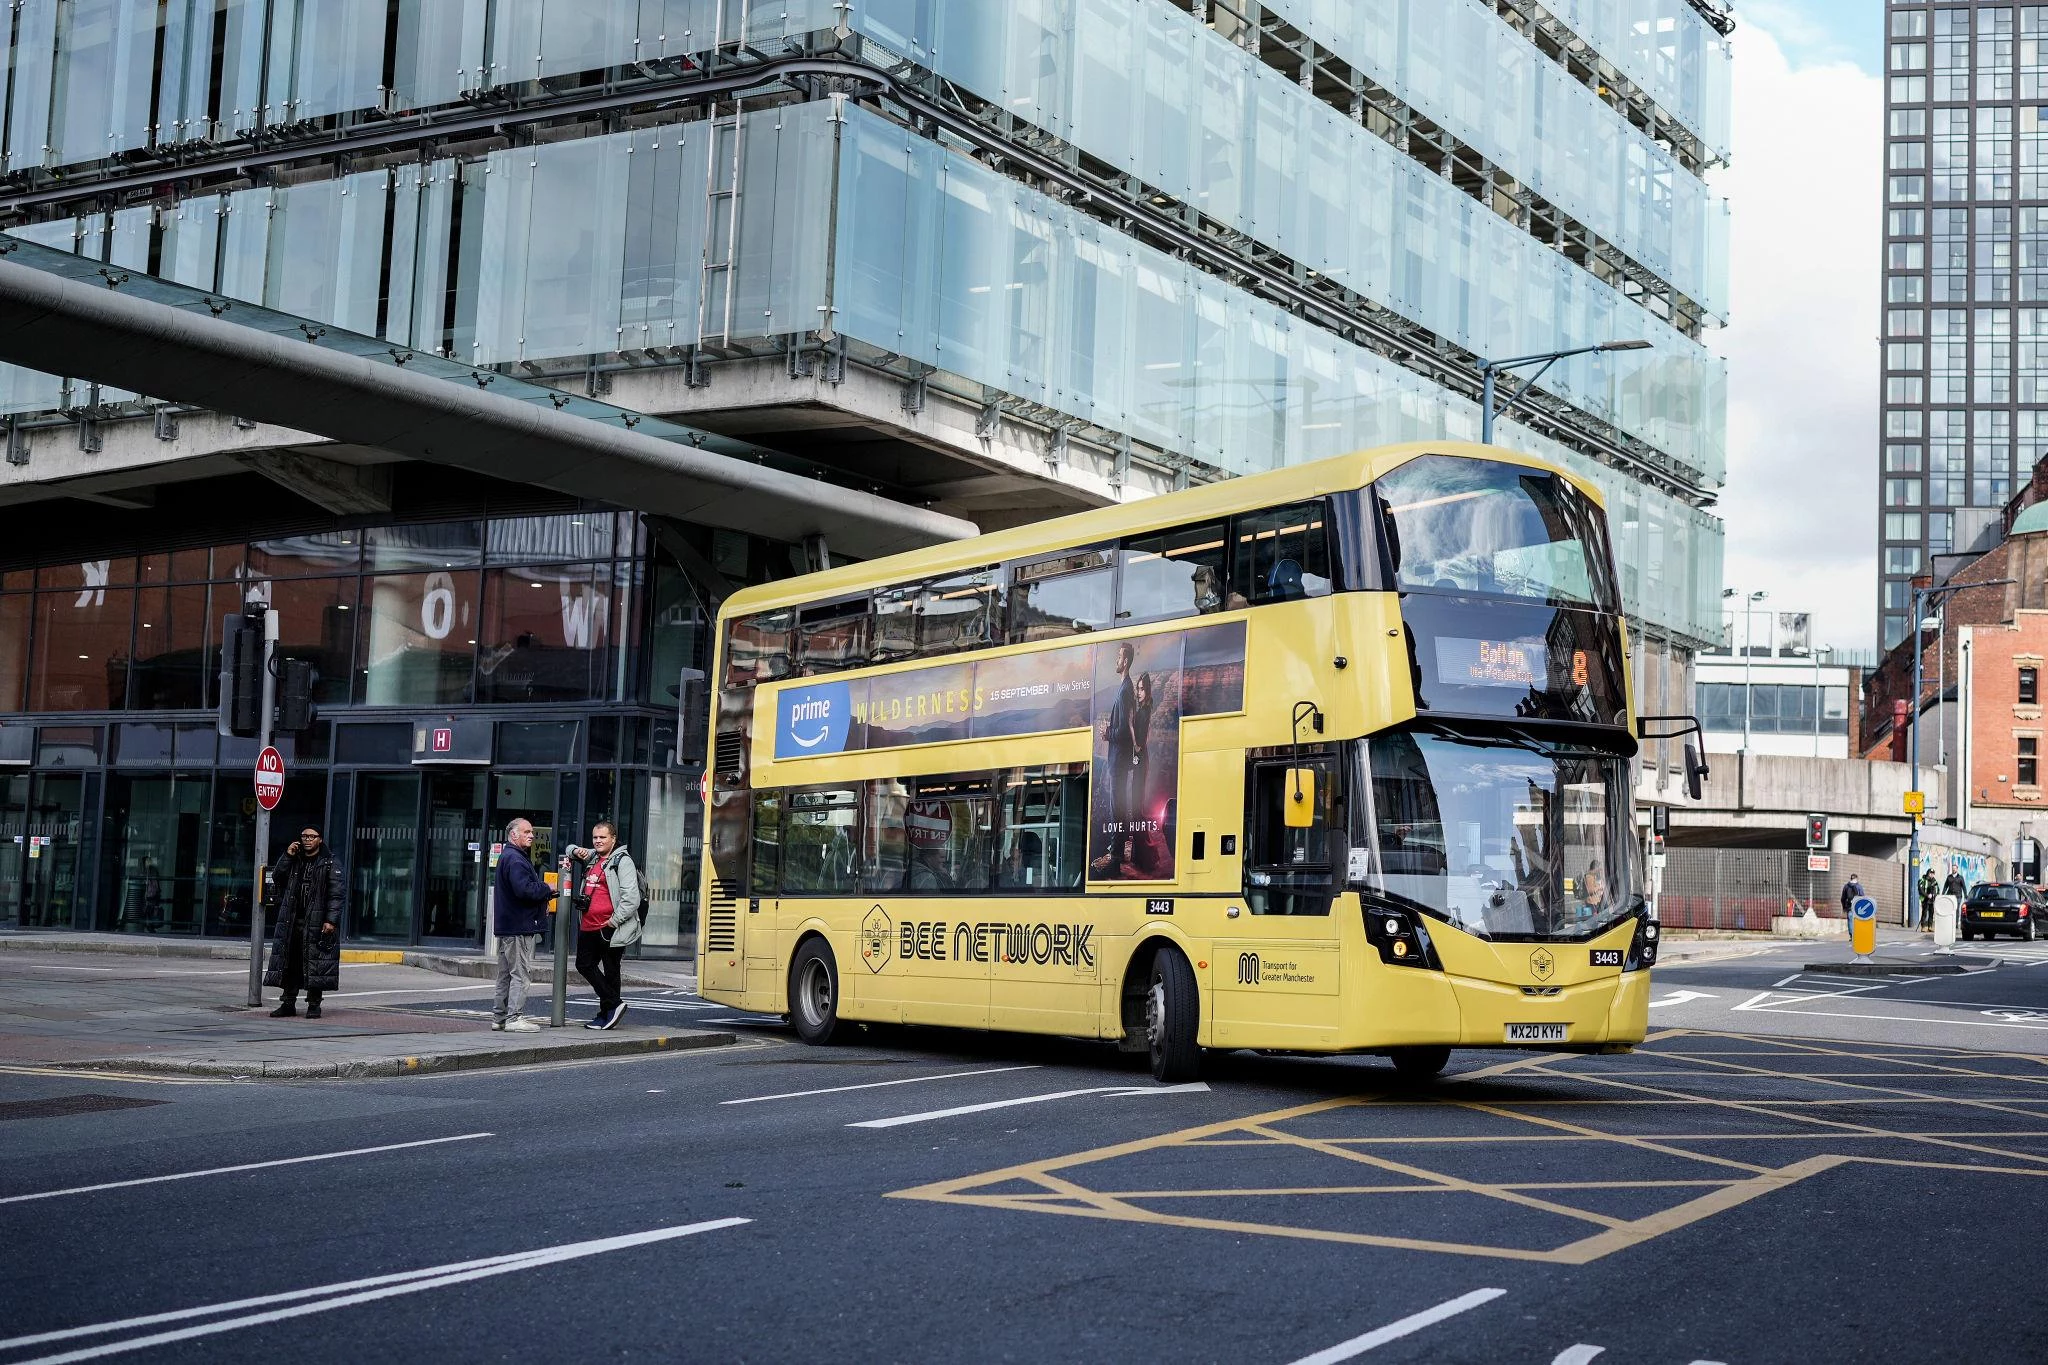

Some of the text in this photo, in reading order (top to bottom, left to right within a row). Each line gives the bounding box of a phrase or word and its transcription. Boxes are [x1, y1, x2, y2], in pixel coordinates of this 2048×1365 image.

[1480, 641, 1524, 666] Bolton
[1572, 651, 1587, 686] 8
[990, 679, 1090, 701] 15 SEPTEMBER New Series
[791, 696, 830, 728] prime
[856, 688, 985, 725] WILDERNESS
[437, 732, 446, 747] H
[263, 755, 277, 770] NO
[258, 786, 279, 797] ENTRY
[1102, 820, 1160, 833] LOVE. HURTS.
[1150, 901, 1170, 913] 3443
[899, 921, 1094, 966] BEE NETWORK
[1595, 951, 1618, 964] 3443
[1262, 960, 1297, 971] Transport for
[1262, 972, 1315, 983] Greater Manchester
[1511, 1025, 1563, 1039] MX20 KYH
